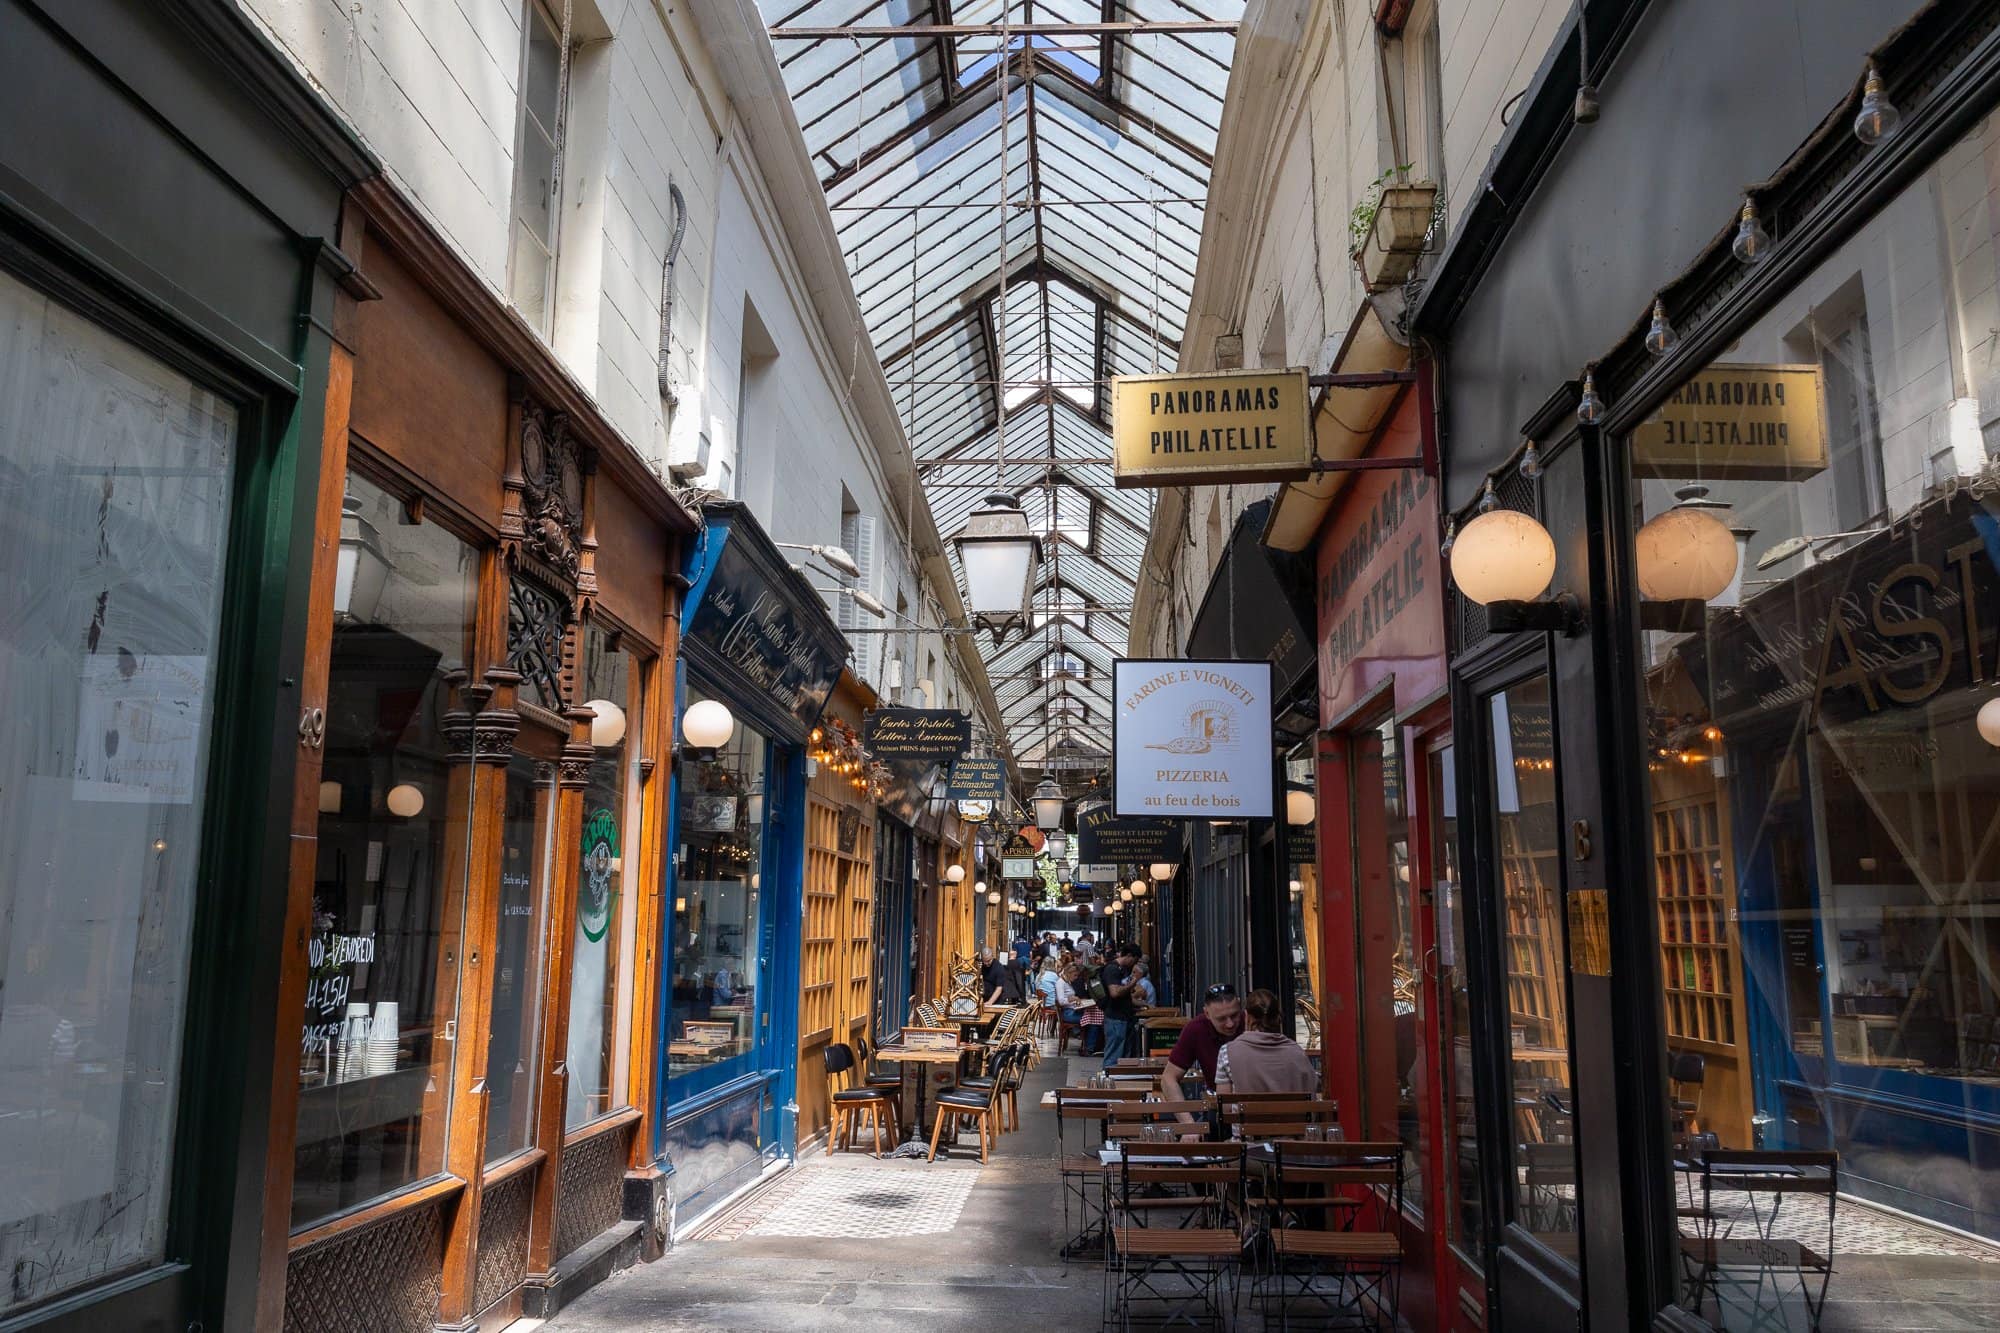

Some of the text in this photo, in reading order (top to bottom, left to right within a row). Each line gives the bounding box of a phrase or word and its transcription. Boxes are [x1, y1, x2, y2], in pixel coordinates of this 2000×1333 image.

[1150, 386, 1279, 415] PANORAMAS
[1150, 426, 1277, 454] PHILATELIE
[1330, 533, 1424, 676] PHILATELIE
[1125, 669, 1257, 711] FARINE E VIGNETI
[880, 716, 955, 729] Cartes Postales
[871, 729, 907, 741] Lettres
[919, 745, 939, 753] depuis
[1155, 770, 1231, 783] PIZZERIA
[950, 781, 995, 789] Estimation
[1144, 794, 1242, 807] au feu de bois
